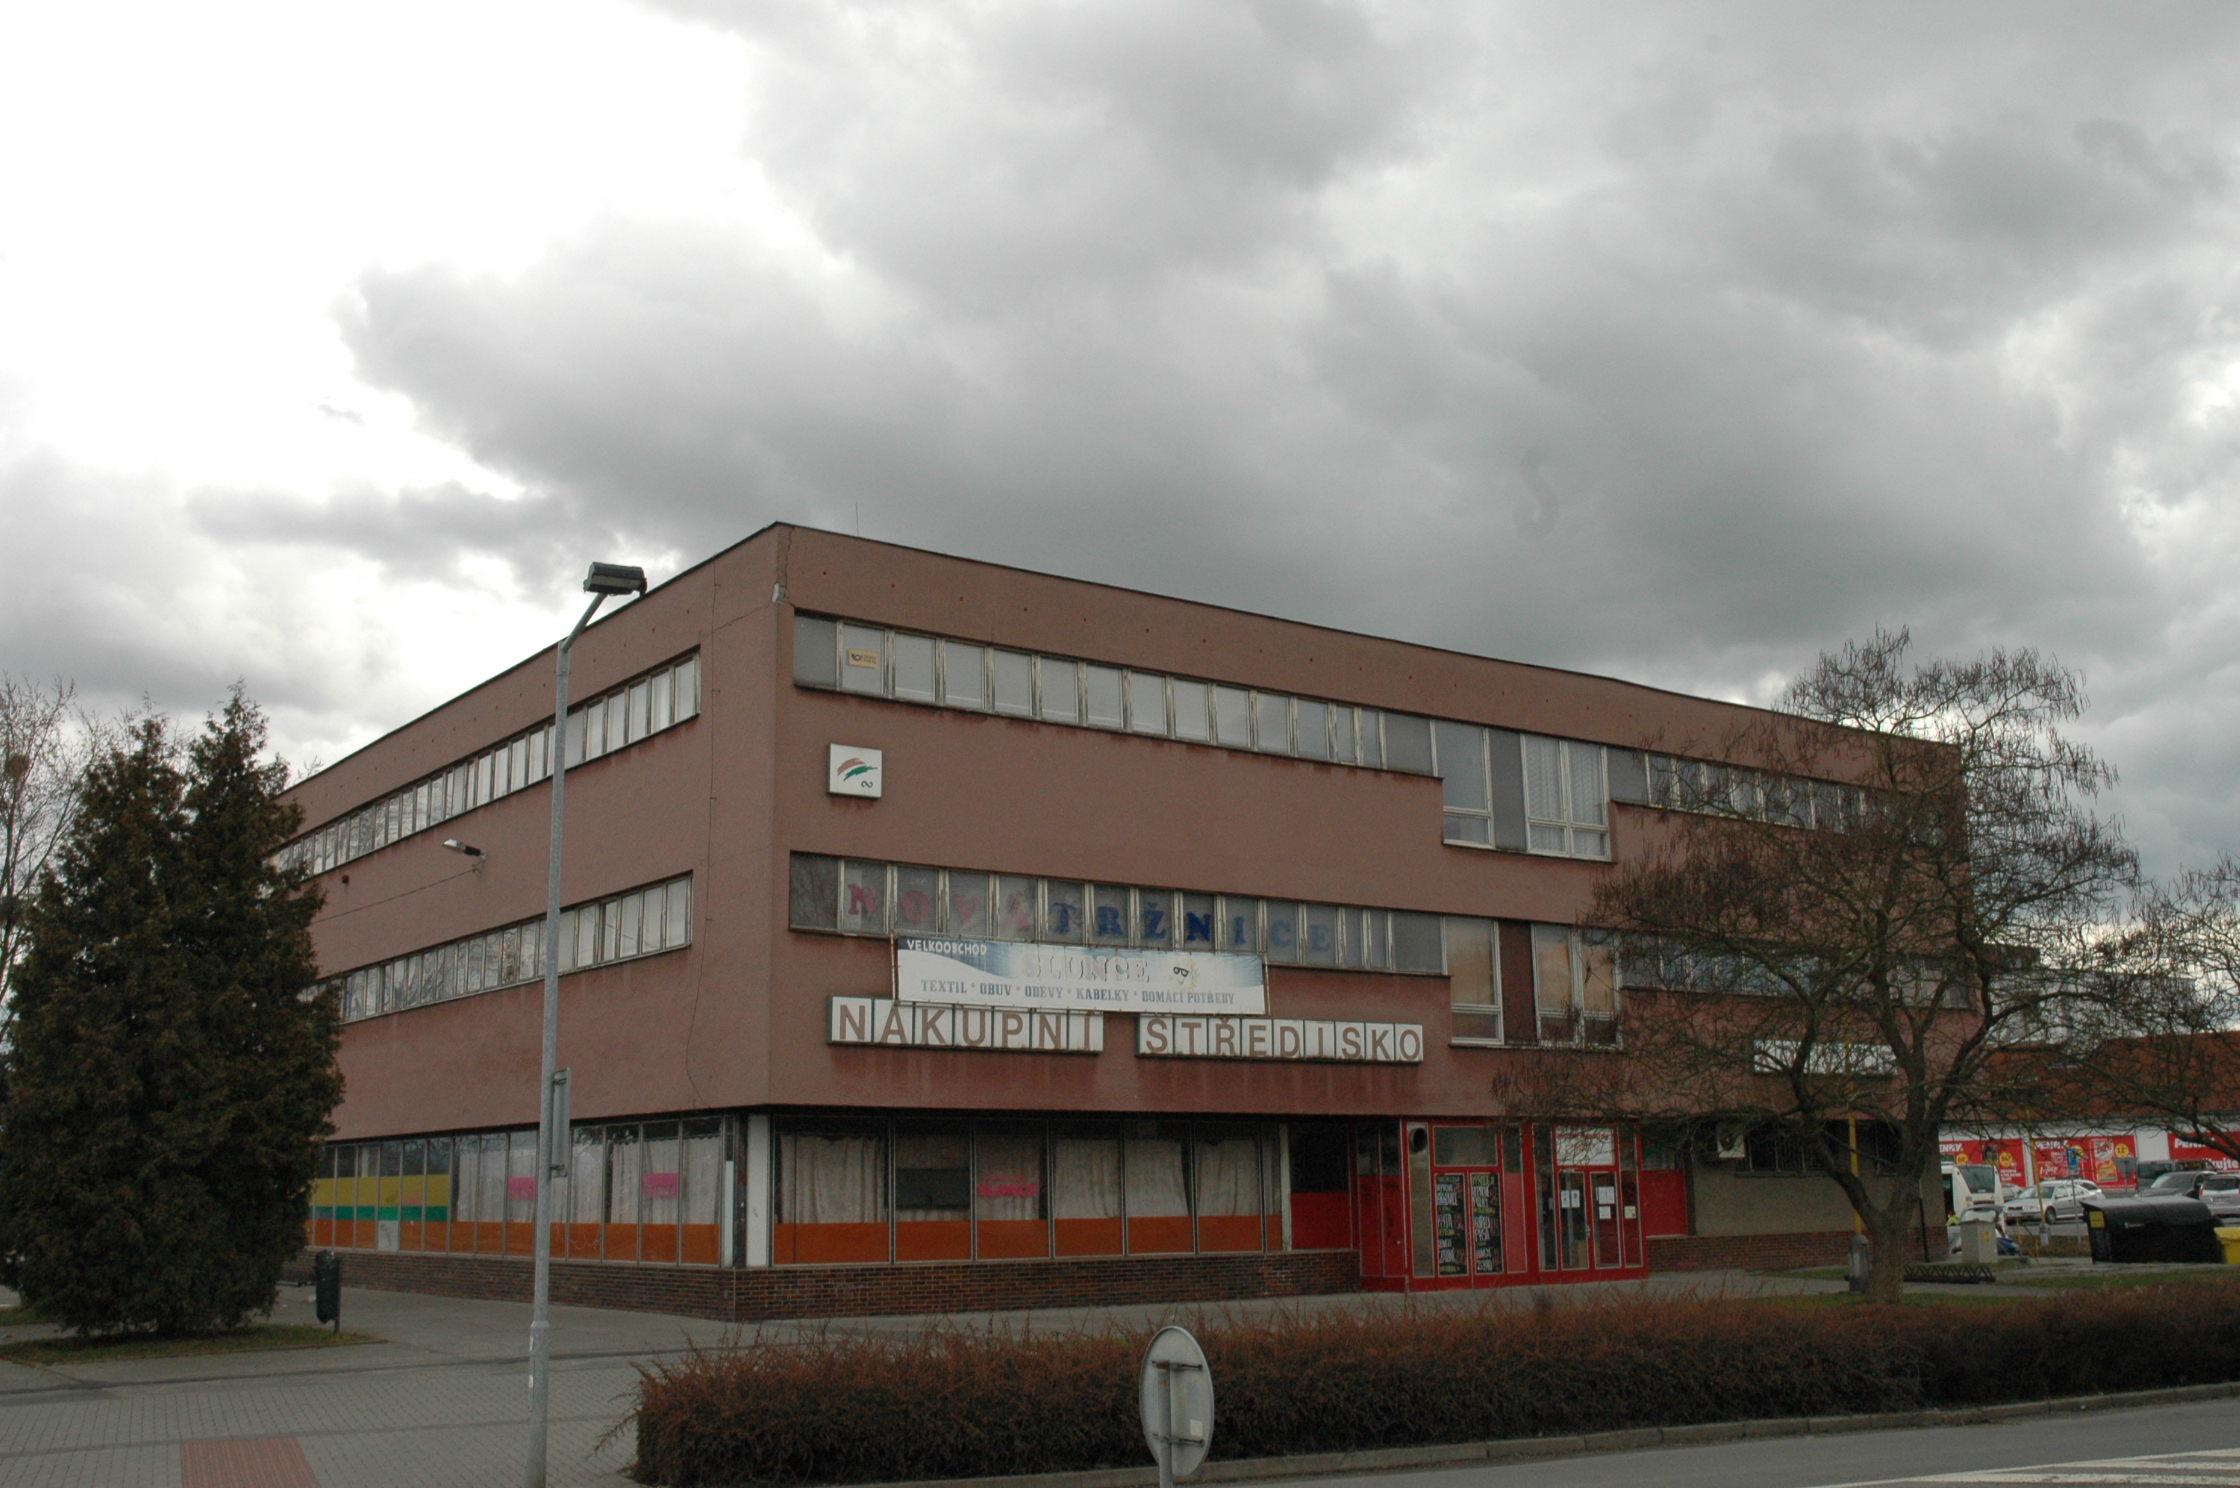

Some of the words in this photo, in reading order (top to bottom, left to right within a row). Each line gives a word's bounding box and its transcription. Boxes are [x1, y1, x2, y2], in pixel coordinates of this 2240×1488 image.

[1053, 901, 1330, 951] TRŽNICE
[906, 939, 988, 956] VELKOOBCHOD
[920, 979, 968, 995] TEXTIL
[979, 982, 1013, 997] OBUV
[1076, 986, 1130, 1001] KABELKY
[1145, 1016, 1421, 1062] STŘEDISKO
